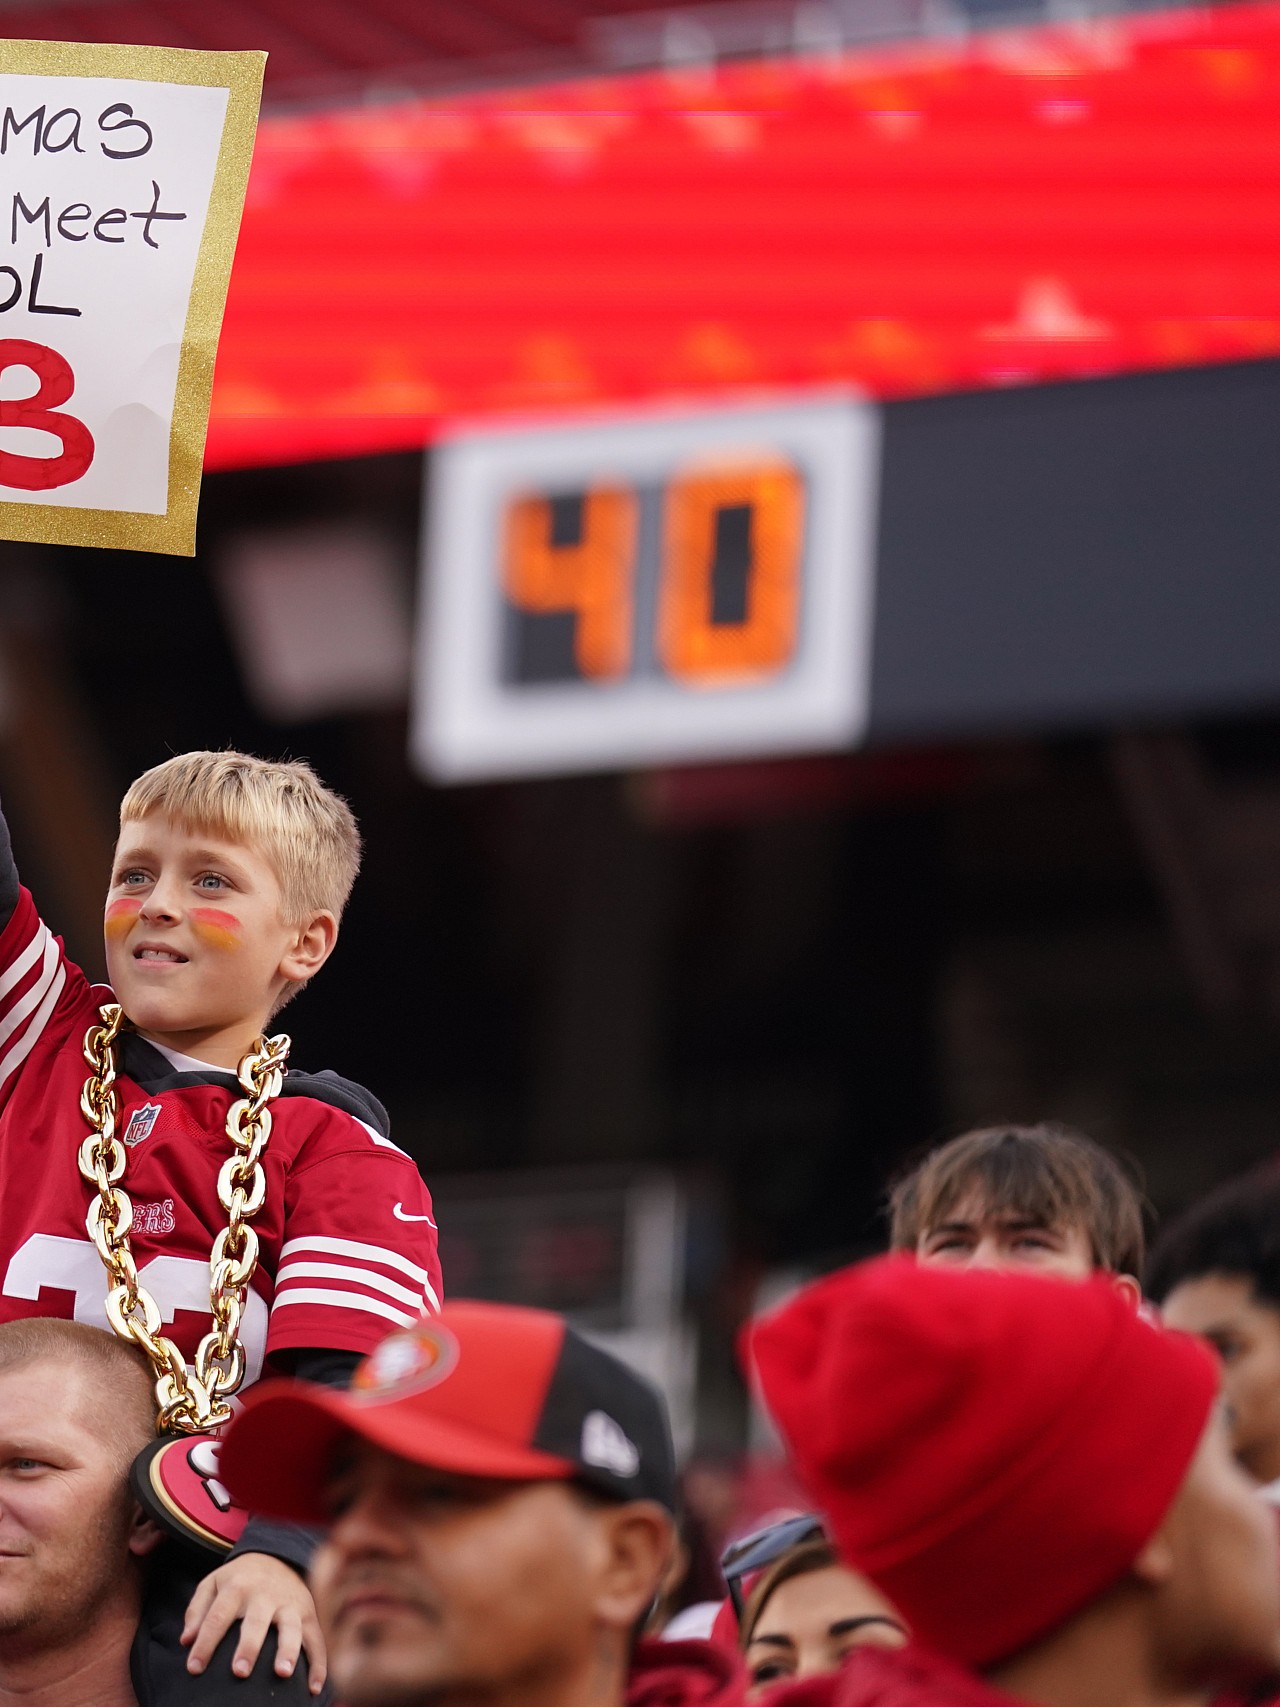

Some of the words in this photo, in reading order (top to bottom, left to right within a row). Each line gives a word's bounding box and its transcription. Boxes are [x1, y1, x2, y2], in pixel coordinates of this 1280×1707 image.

[499, 451, 808, 691] 40
[127, 1121, 148, 1140] NFL
[130, 1199, 175, 1234] ERS
